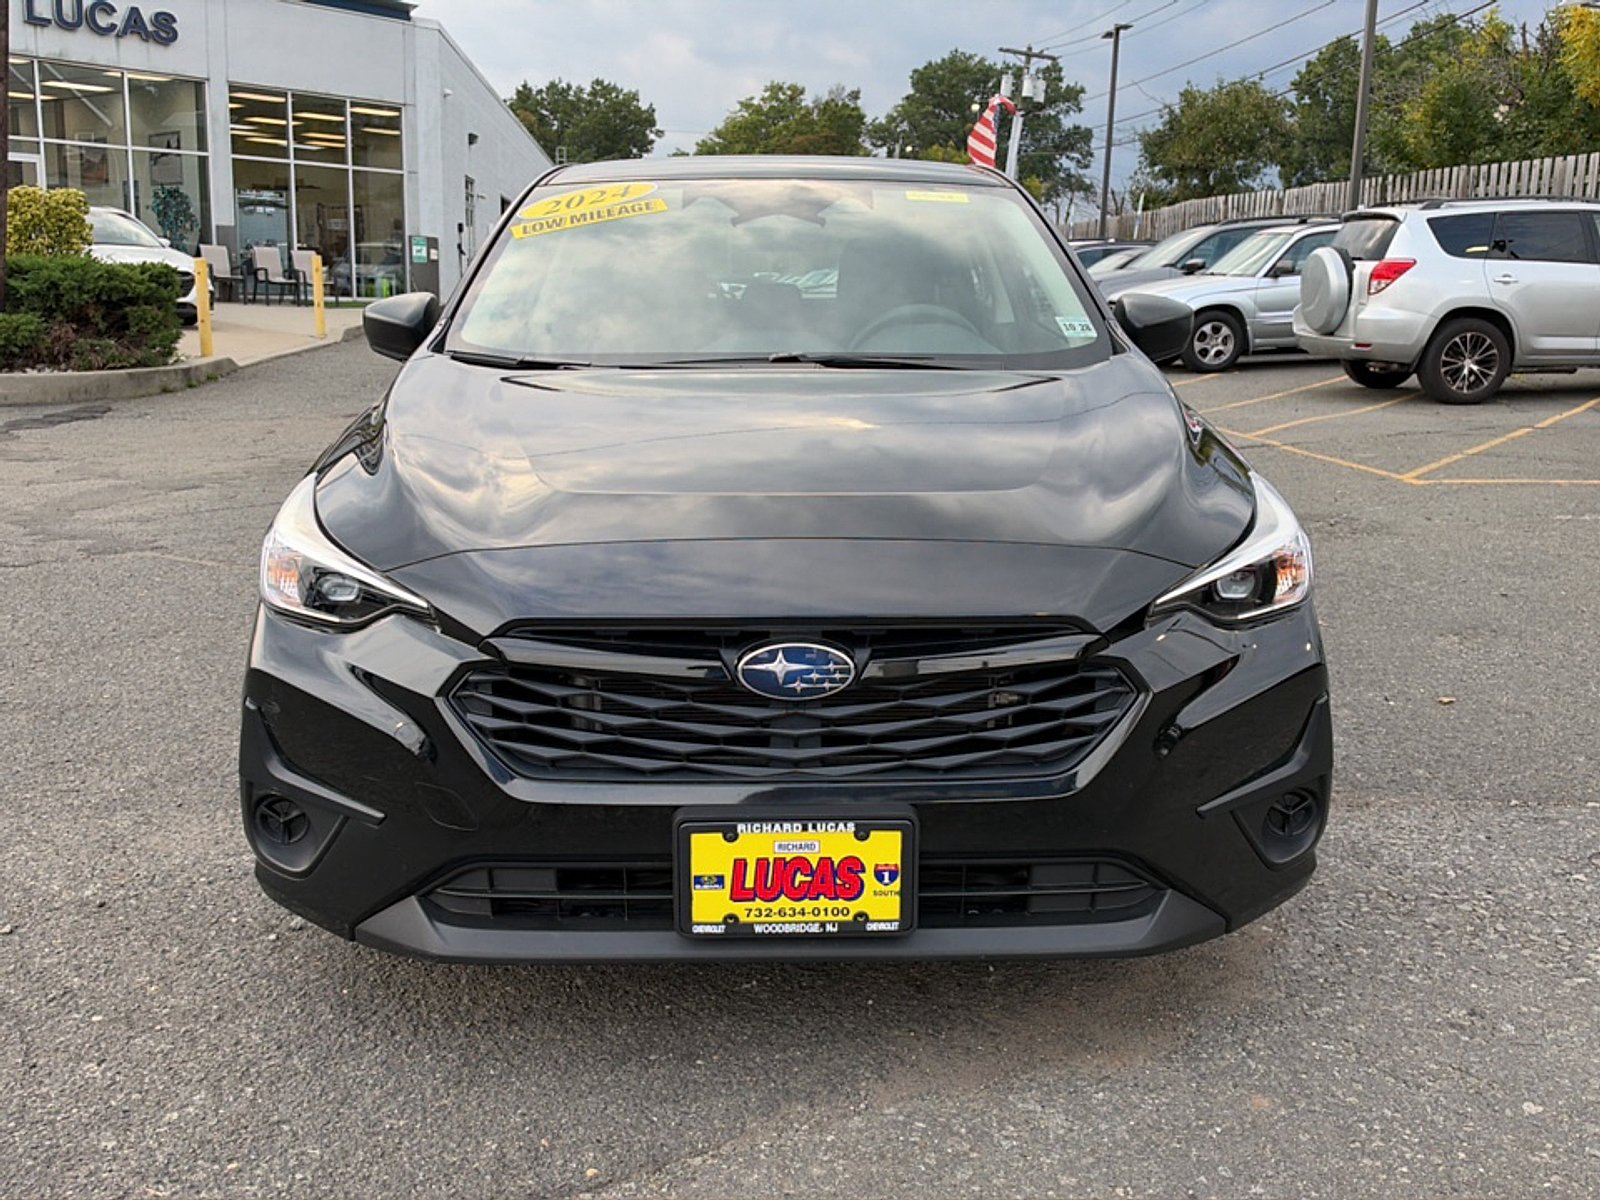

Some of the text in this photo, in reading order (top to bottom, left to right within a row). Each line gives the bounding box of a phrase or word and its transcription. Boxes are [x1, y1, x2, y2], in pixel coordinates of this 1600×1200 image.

[24, 0, 179, 46] LUCAS
[544, 183, 632, 215] 2024
[522, 203, 655, 235] LOW MILEAGE
[737, 822, 855, 834] RICHARD LUCAS
[777, 842, 816, 852] RICHARD
[729, 856, 865, 903] LUCAS
[744, 907, 850, 918] 732-634-0100
[826, 922, 838, 933] NJ
